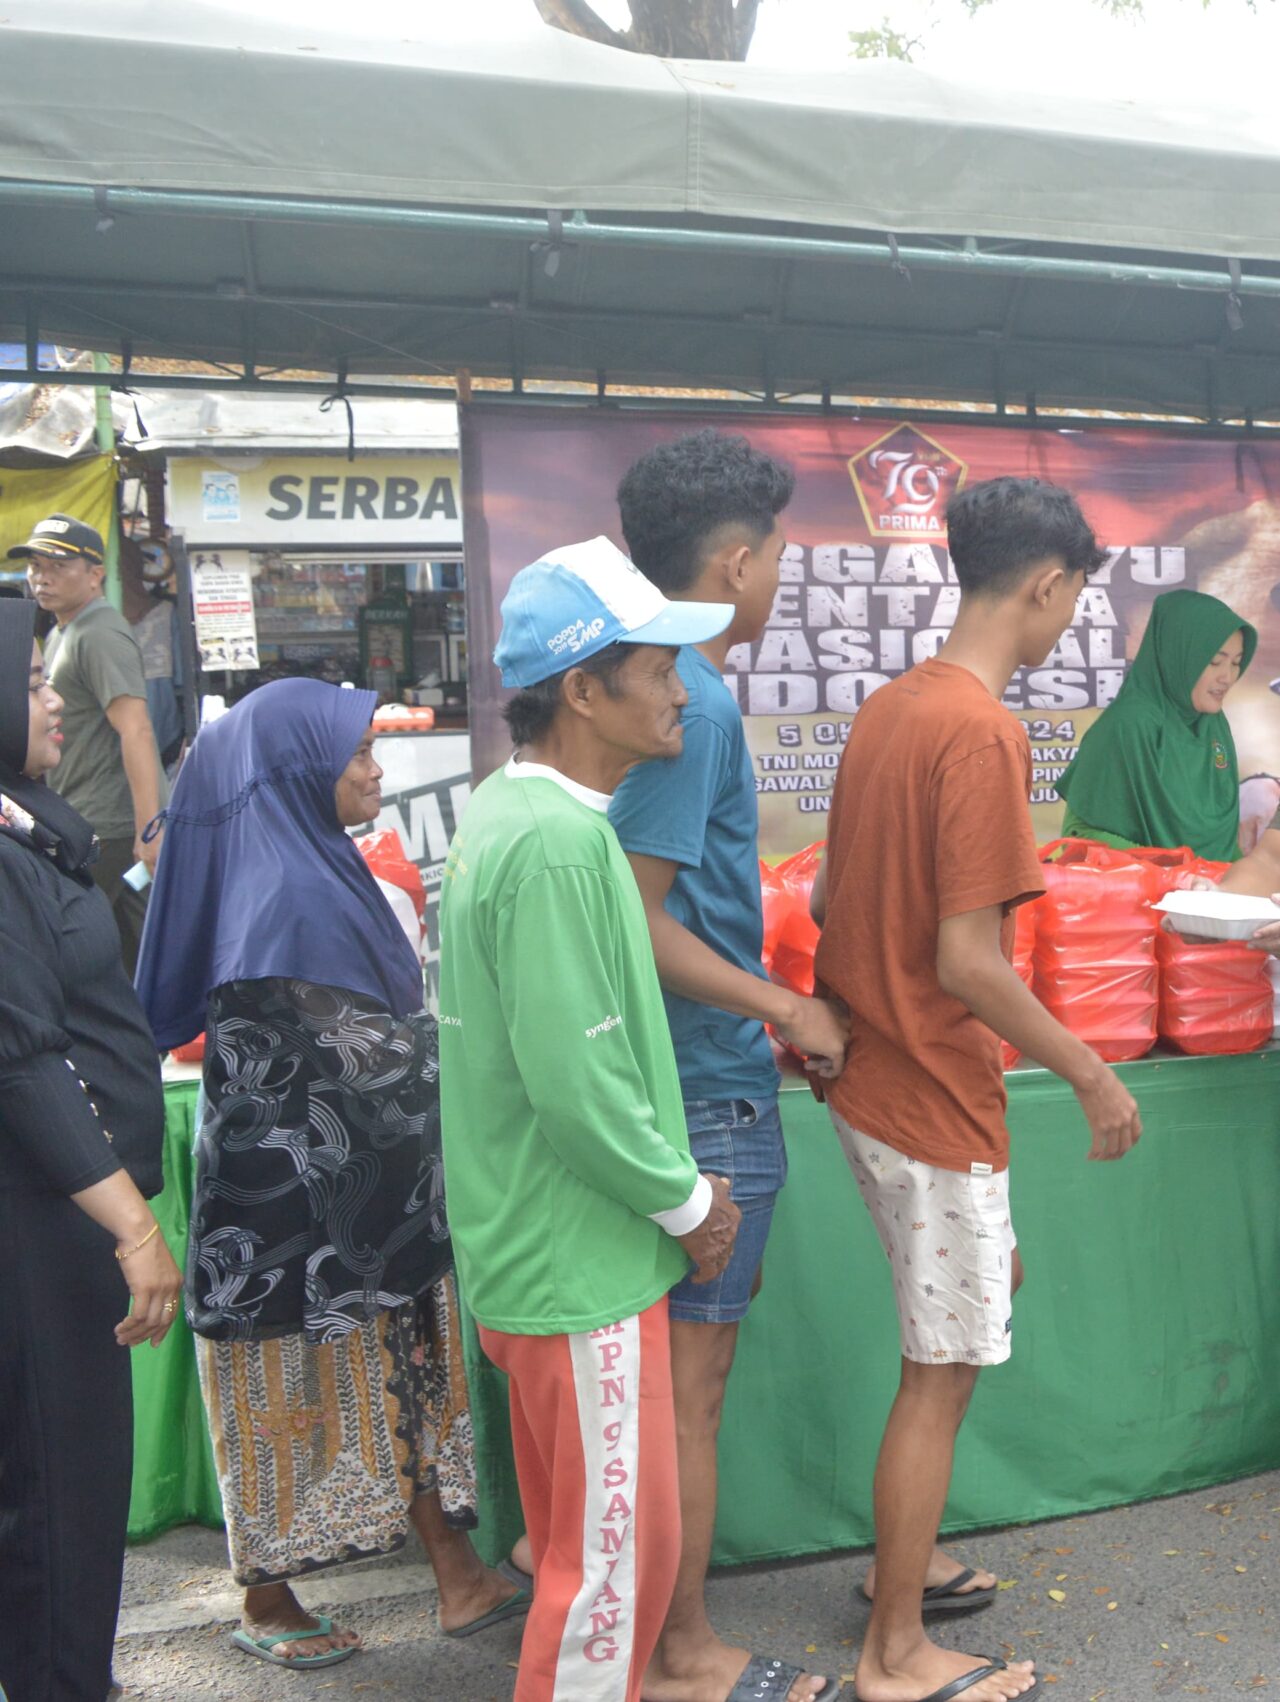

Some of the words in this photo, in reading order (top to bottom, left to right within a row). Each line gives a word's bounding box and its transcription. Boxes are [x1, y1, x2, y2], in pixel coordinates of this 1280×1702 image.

[265, 475, 458, 521] SERBA
[879, 515, 940, 531] PRIMA
[567, 617, 605, 653] SMP
[778, 724, 801, 747] 5
[759, 754, 797, 770] TNI
[803, 753, 839, 769] MO
[585, 1015, 622, 1038] syngen
[603, 1421, 621, 1451] 9
